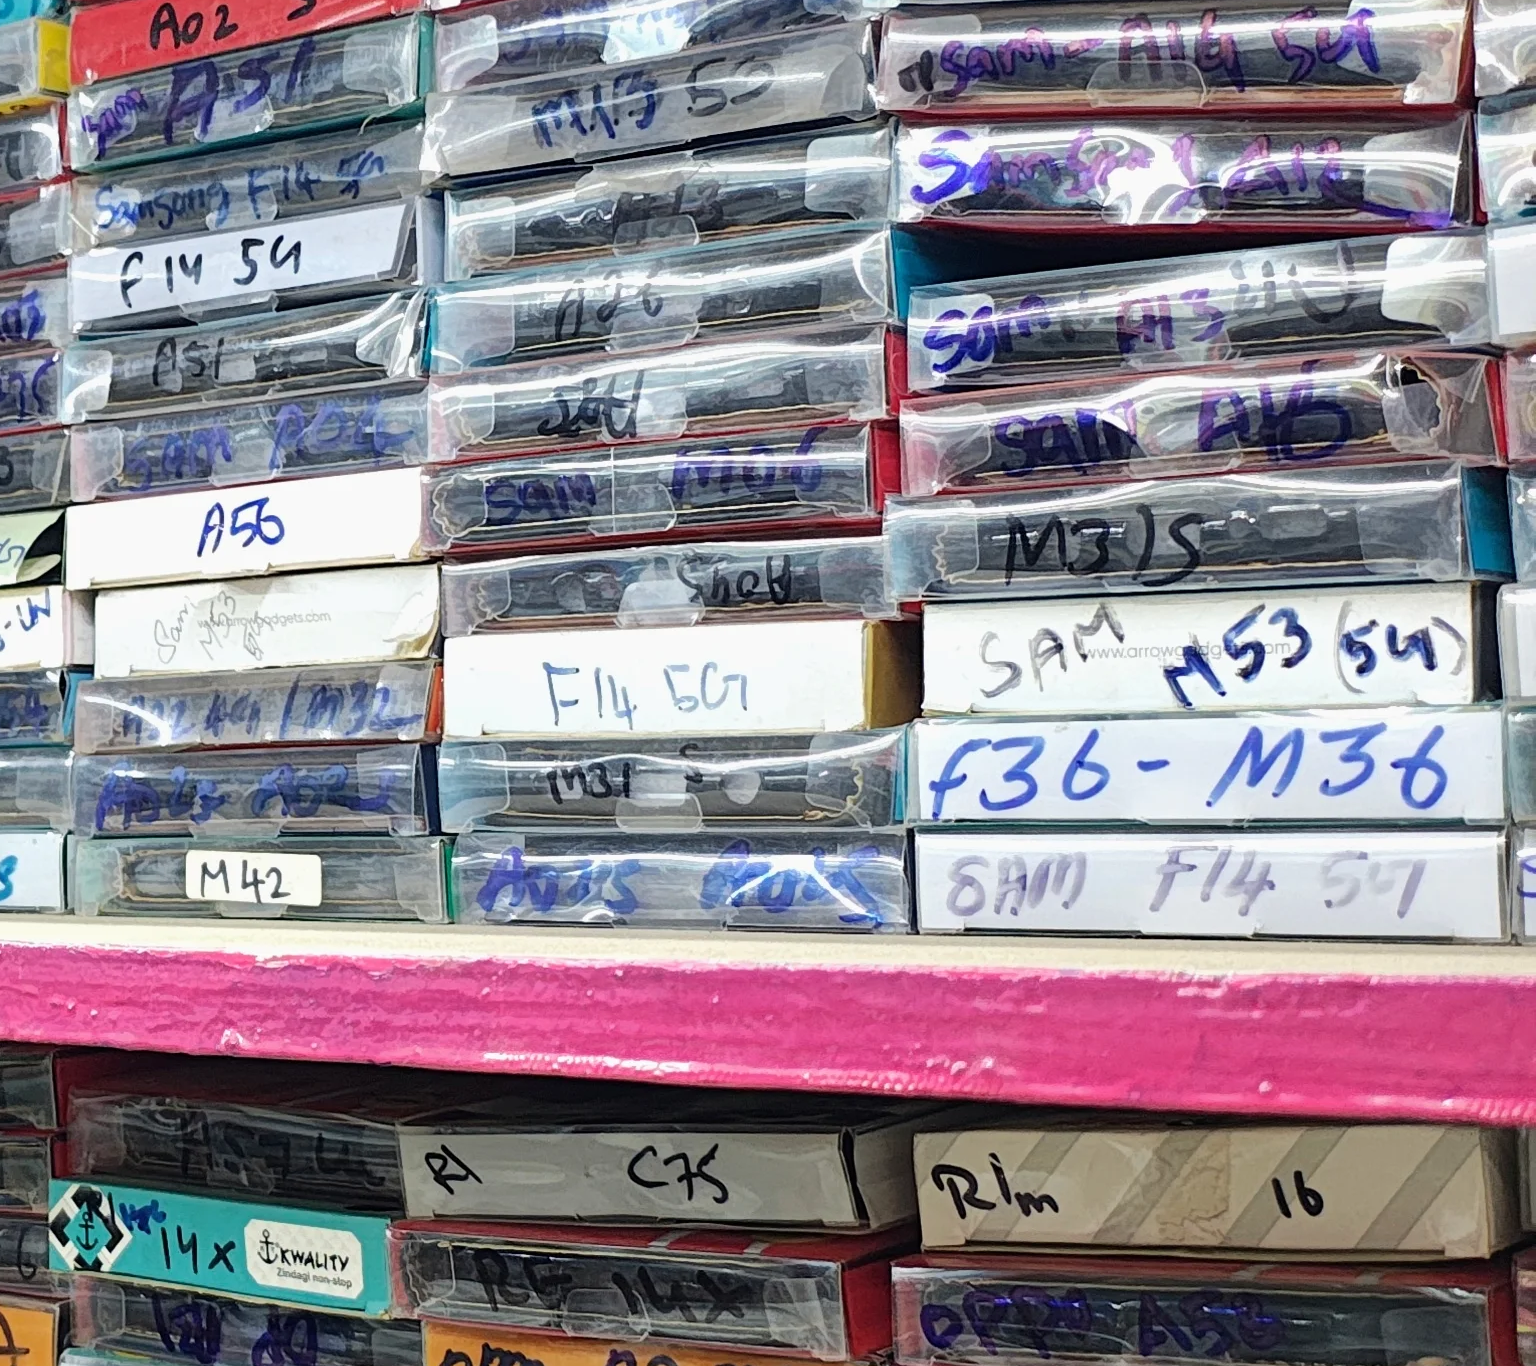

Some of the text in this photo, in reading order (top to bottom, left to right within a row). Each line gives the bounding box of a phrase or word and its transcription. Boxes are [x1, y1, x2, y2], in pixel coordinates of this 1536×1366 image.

[150, 3, 239, 49] A02
[979, 601, 1126, 699] SAM
[542, 661, 749, 730] F14 5G
[1205, 724, 1448, 810] M36
[946, 851, 1087, 917] SAM
[1149, 845, 1276, 917] F14
[1271, 1170, 1324, 1218] 16
[280, 1246, 349, 1273] KWALITY
